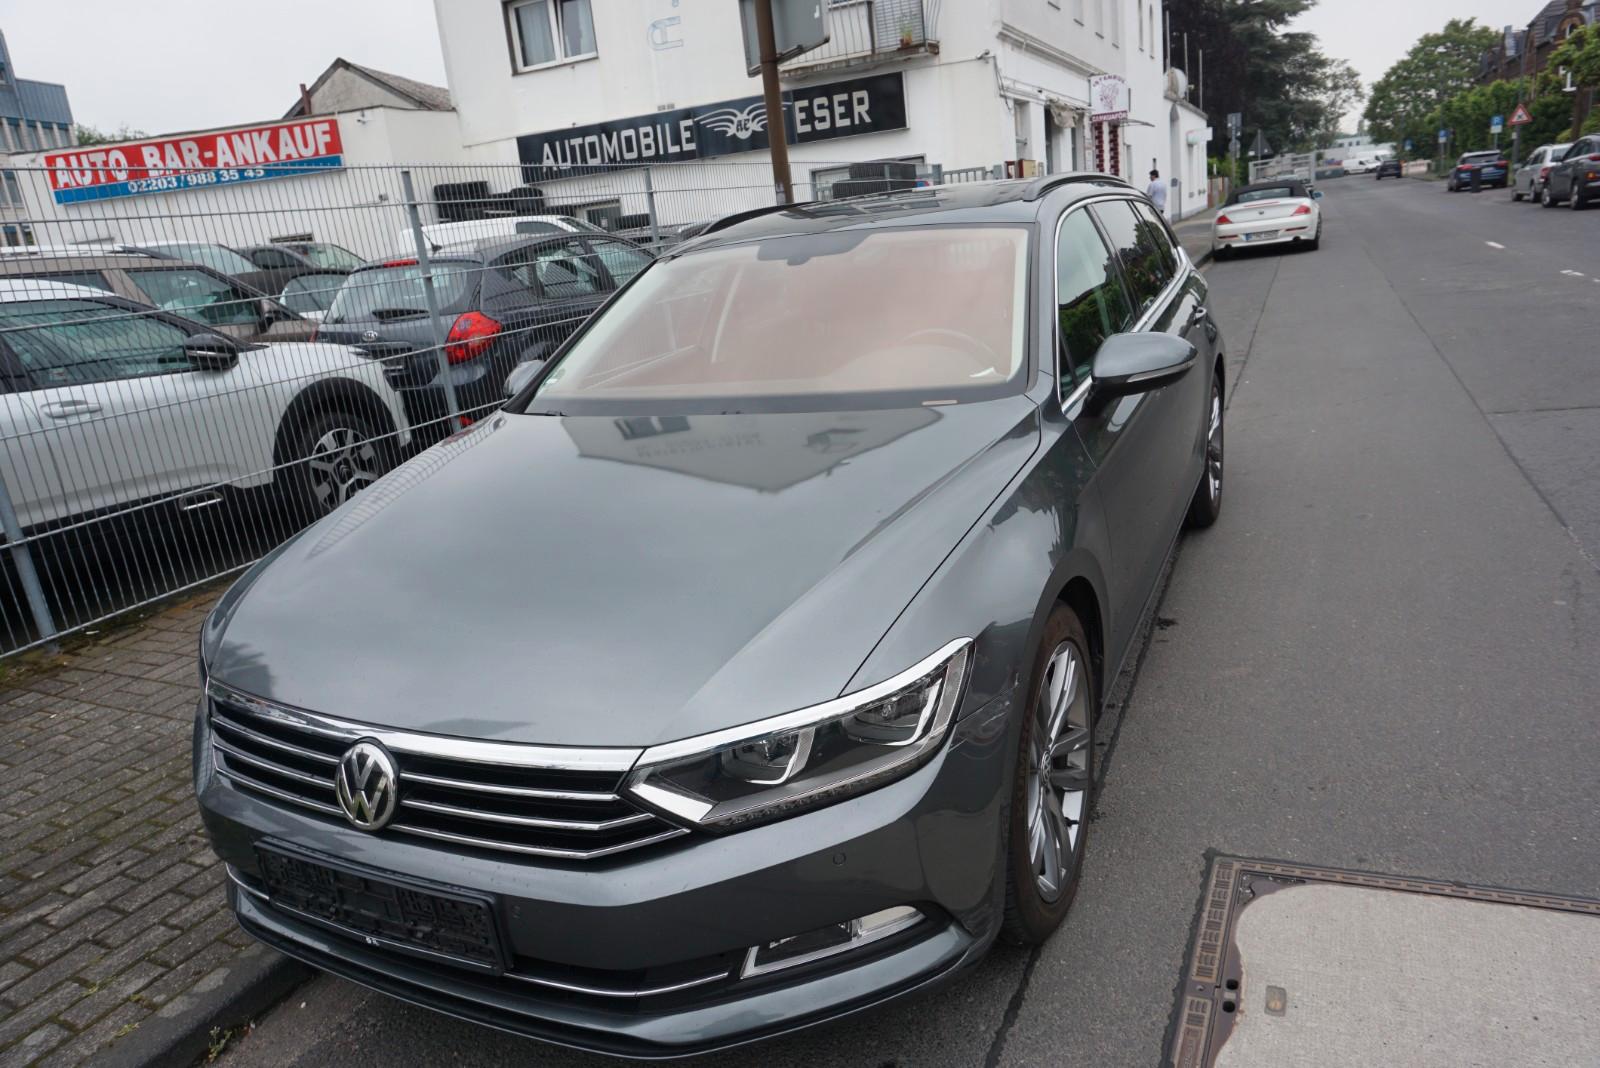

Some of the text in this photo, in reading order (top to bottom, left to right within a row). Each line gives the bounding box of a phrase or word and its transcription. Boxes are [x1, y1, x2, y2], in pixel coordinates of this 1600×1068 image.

[55, 122, 331, 189] AUTO BAR-ANKAUF
[542, 90, 872, 172] AUTOMOBILE ESER
[219, 169, 239, 182] 35
[243, 166, 265, 178] 45
